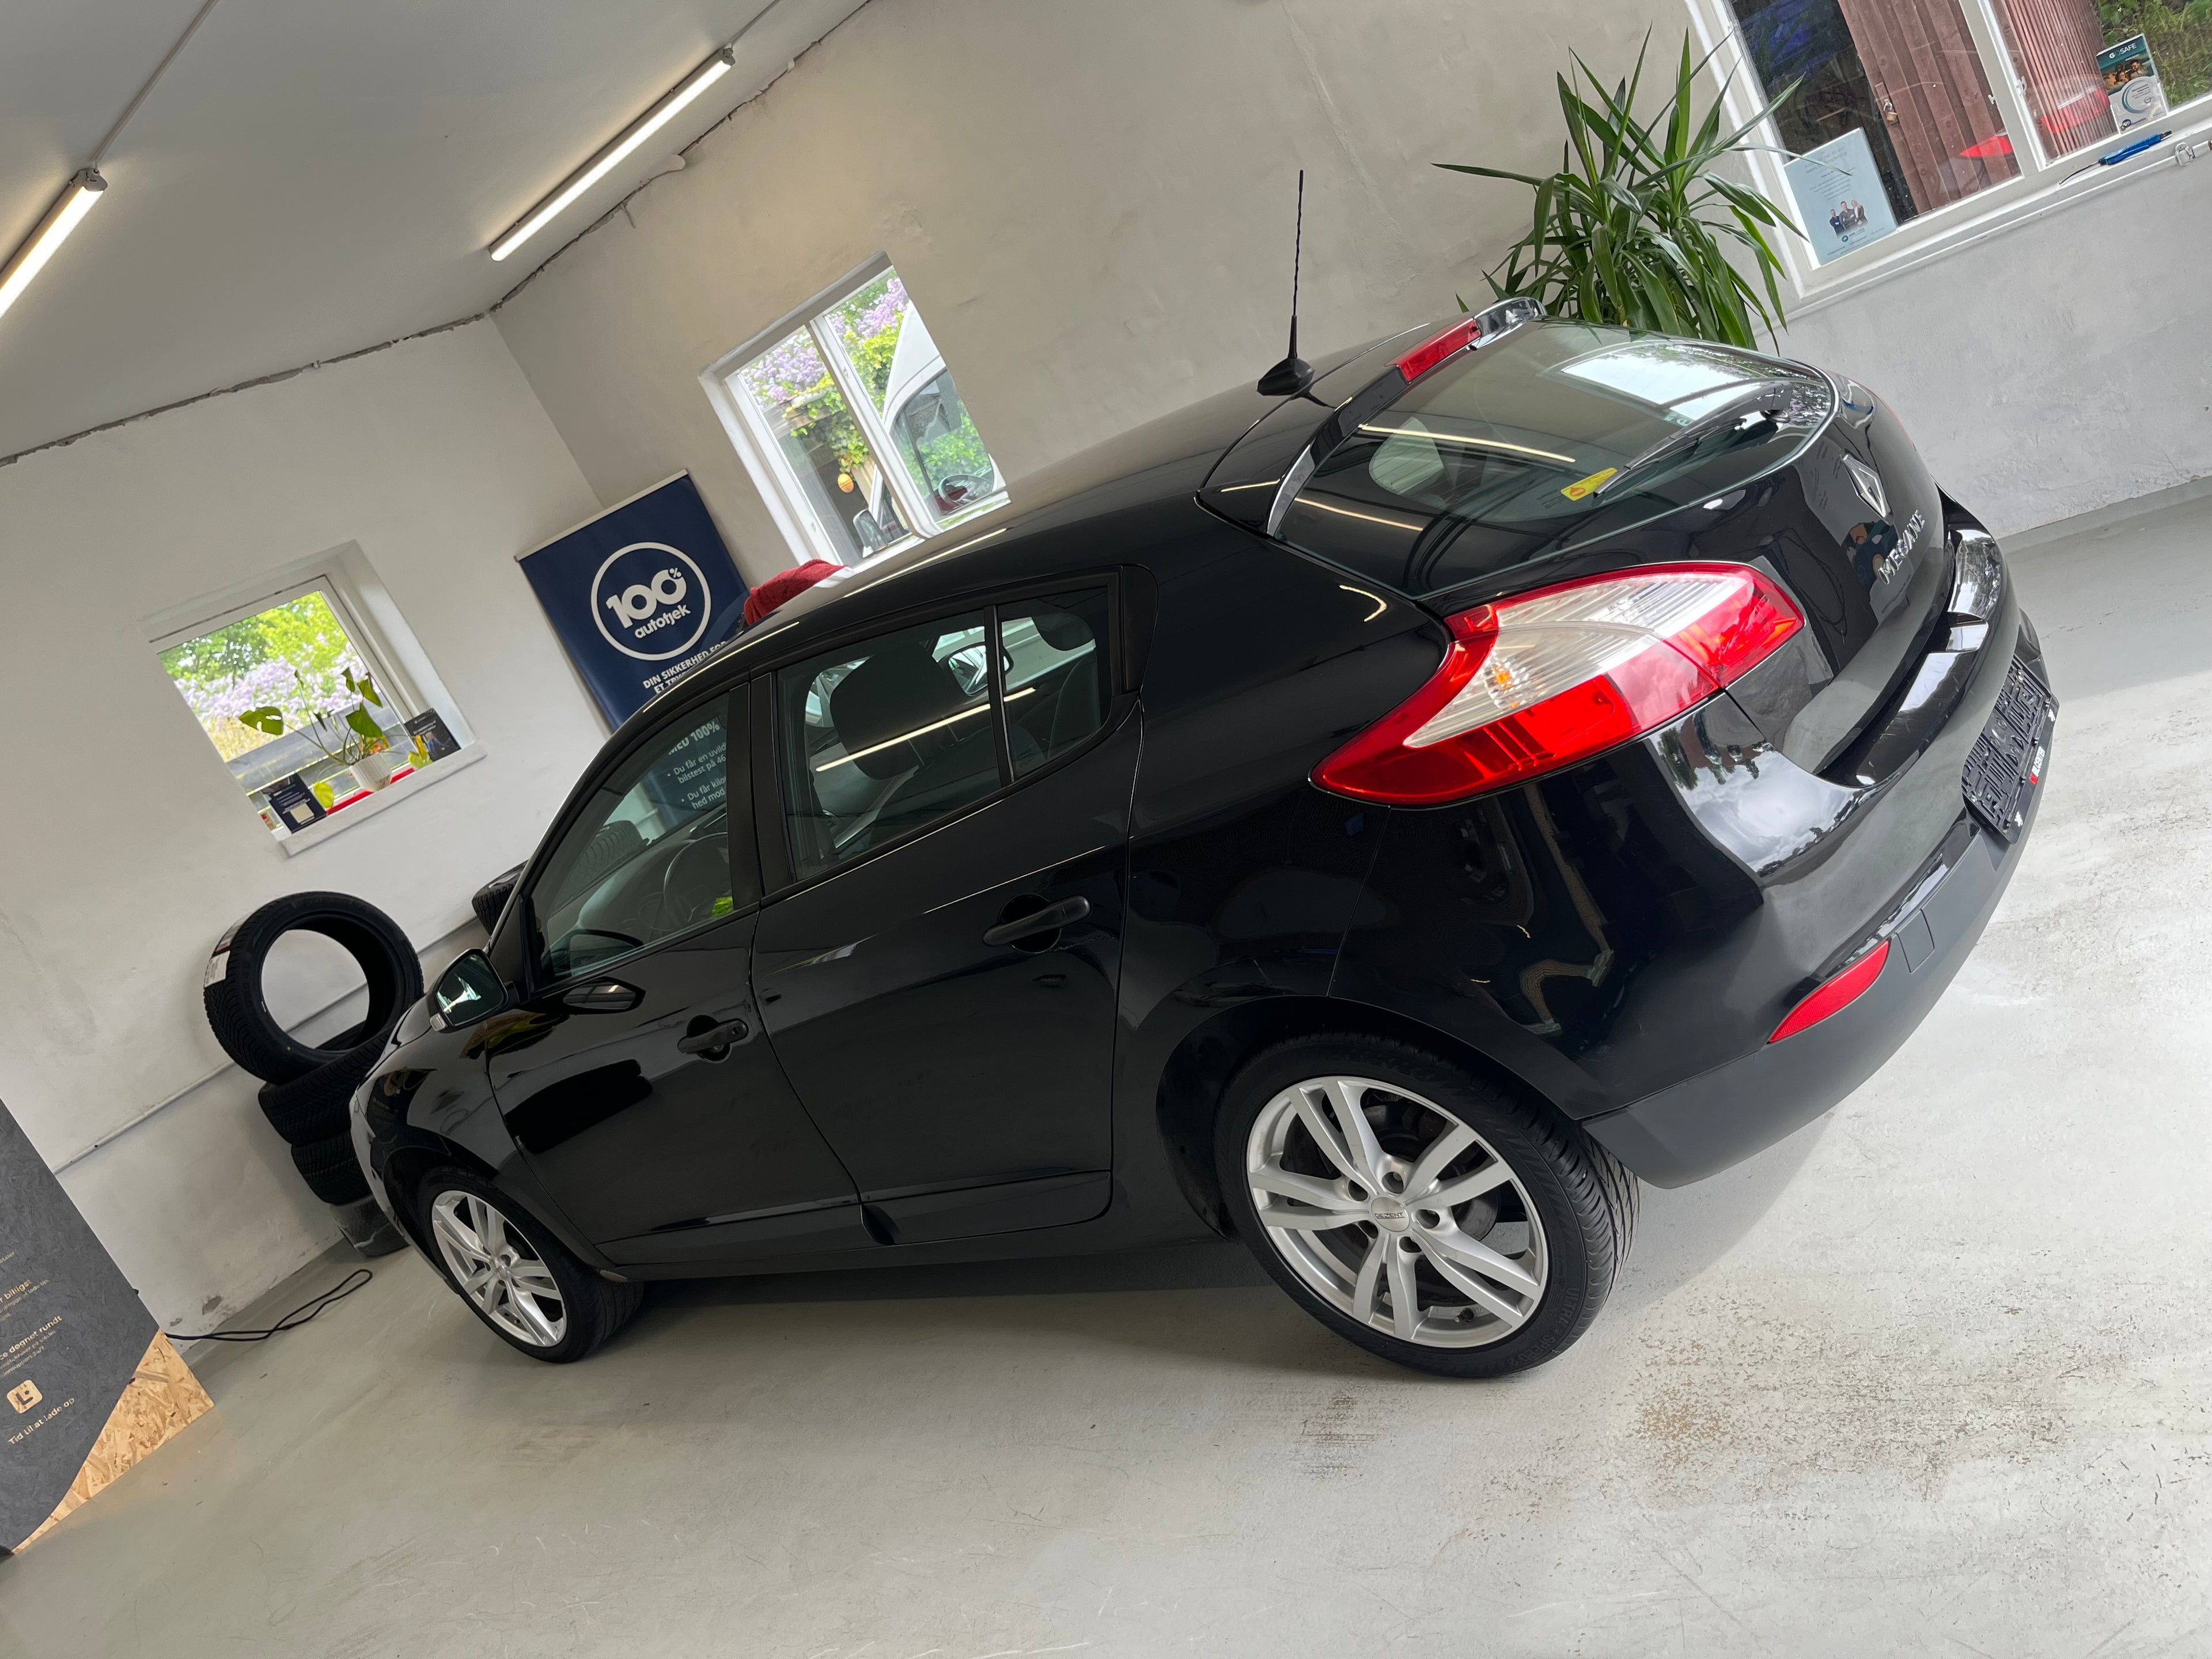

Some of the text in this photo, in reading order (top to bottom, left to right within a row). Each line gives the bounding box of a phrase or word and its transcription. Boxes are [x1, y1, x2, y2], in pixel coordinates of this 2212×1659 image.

[1878, 510, 1925, 585] MEGANE
[643, 674, 661, 689] DIN
[661, 650, 710, 680] SIKKERHED
[654, 684, 665, 694] ET
[691, 721, 720, 741] 100%
[673, 765, 685, 775] Du
[685, 759, 697, 770] får
[698, 753, 709, 763] en
[677, 755, 726, 784] bilstest på 46
[687, 790, 699, 801] Du
[699, 785, 711, 795] får
[692, 787, 726, 810] hed mod
[1555, 1287, 1581, 1327] ULTRA
[39, 1315, 63, 1332] rundt
[8, 1432, 24, 1445] Tid
[34, 1419, 44, 1428] at
[43, 1406, 63, 1421] lade
[63, 1397, 75, 1408] op
